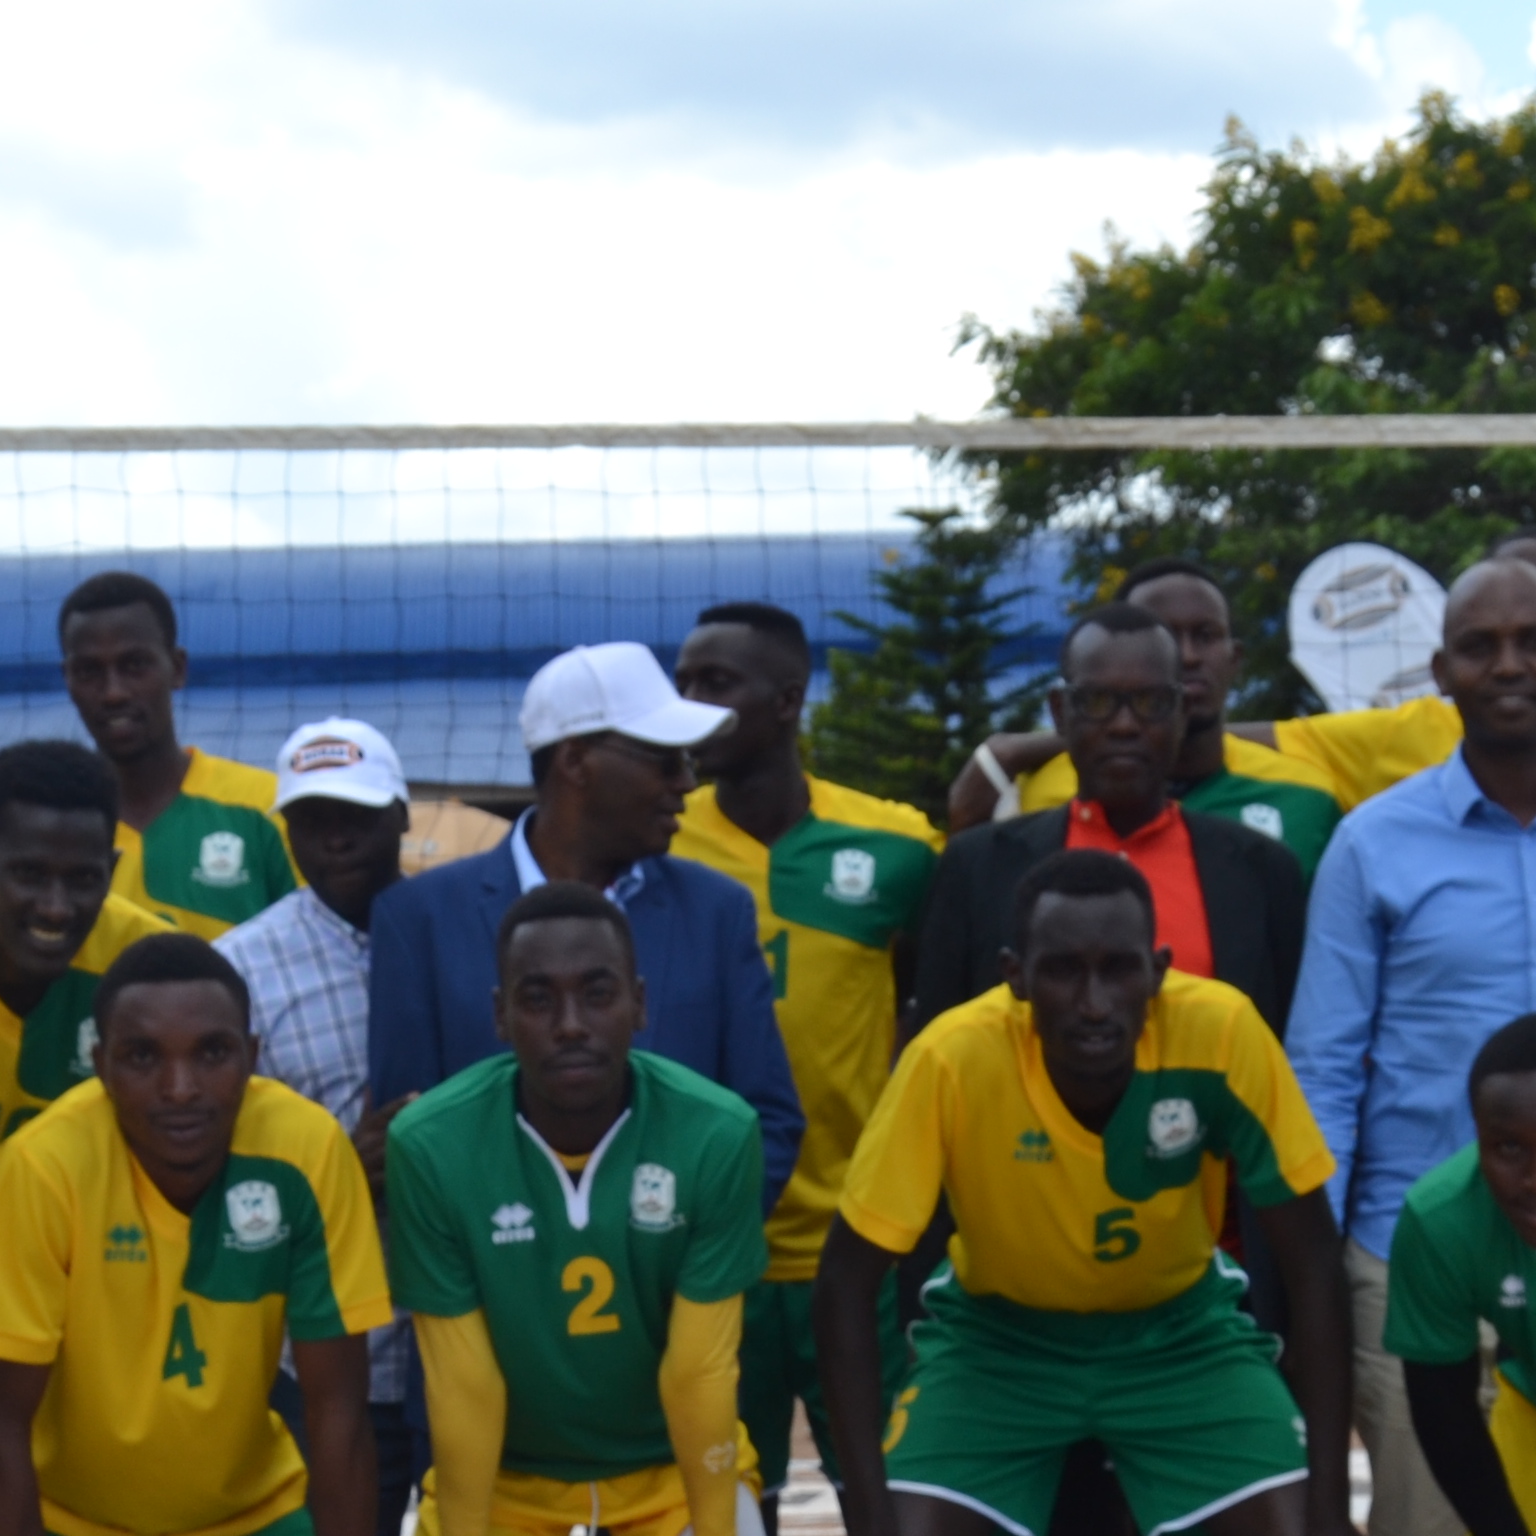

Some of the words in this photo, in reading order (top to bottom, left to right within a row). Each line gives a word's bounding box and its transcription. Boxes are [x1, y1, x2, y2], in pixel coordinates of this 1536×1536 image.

[1093, 1207, 1142, 1264] 5
[561, 1255, 621, 1337] 2
[162, 1302, 208, 1389] 4
